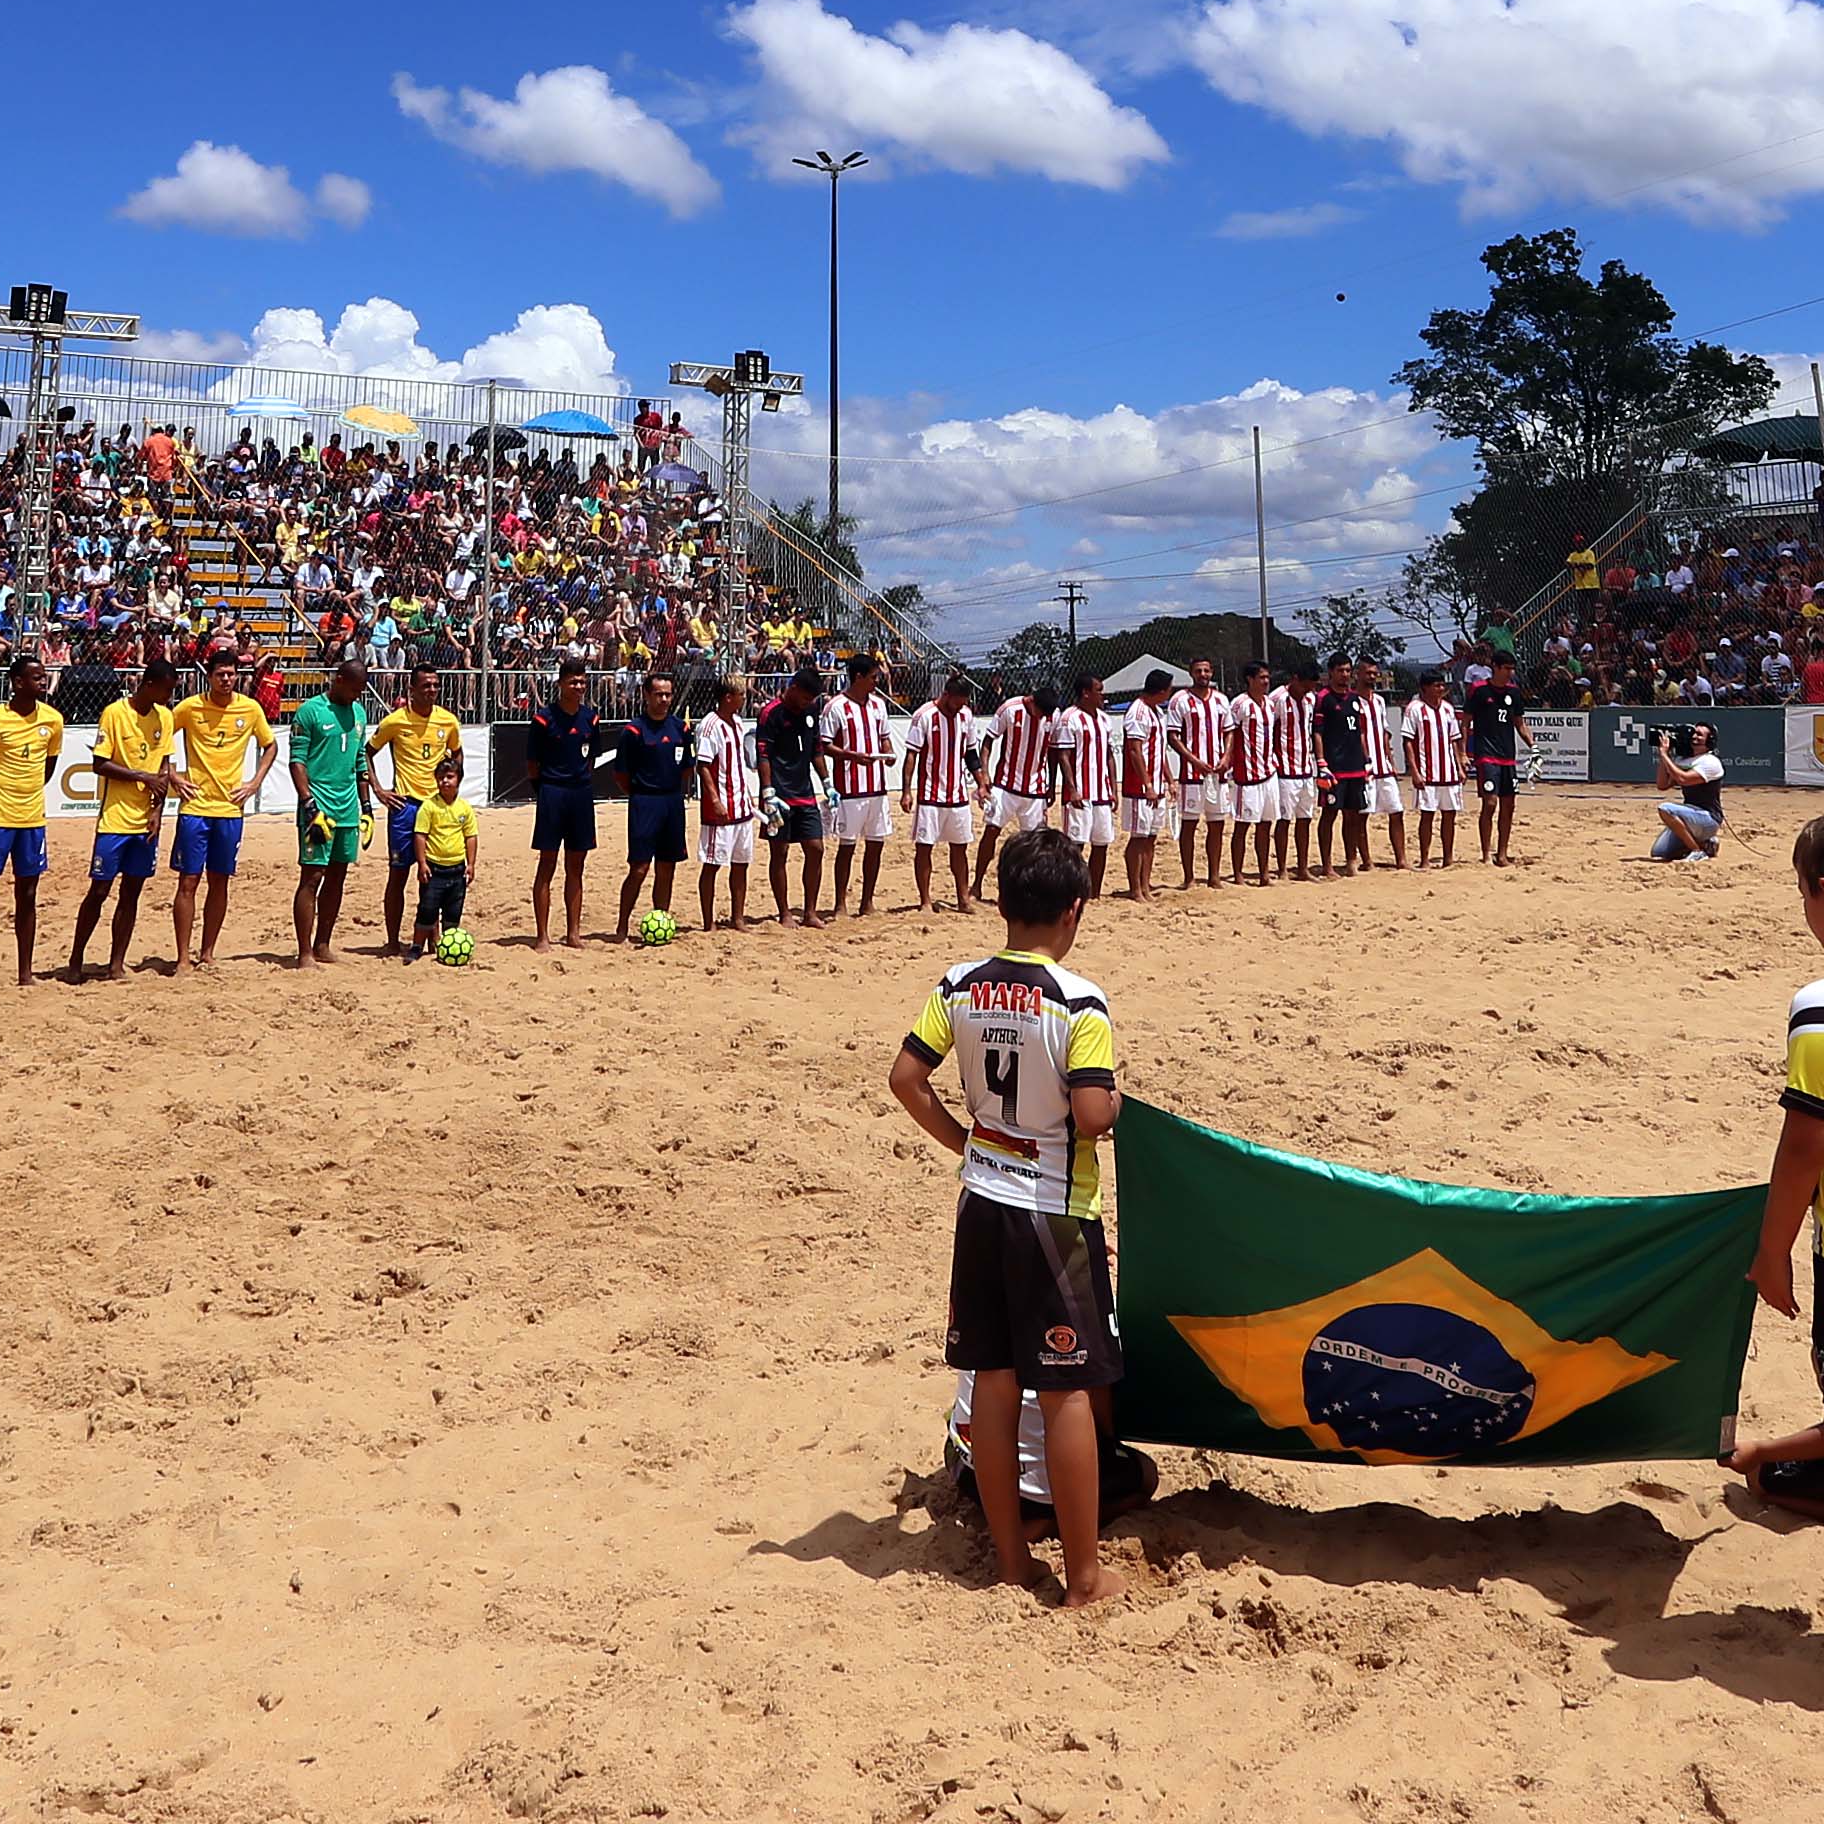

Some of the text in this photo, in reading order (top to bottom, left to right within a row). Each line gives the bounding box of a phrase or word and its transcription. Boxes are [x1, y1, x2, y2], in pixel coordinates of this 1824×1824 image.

[1346, 715, 1357, 731] 12
[1497, 708, 1508, 723] 22
[1522, 716, 1584, 728] UITO MAIS QUE
[216, 731, 225, 748] 2
[340, 733, 347, 752] 1
[139, 742, 149, 760] 3
[422, 743, 430, 759] 8
[969, 981, 1043, 1017] MARA
[984, 1048, 1020, 1127] 4
[1319, 1339, 1384, 1366] ORDEM
